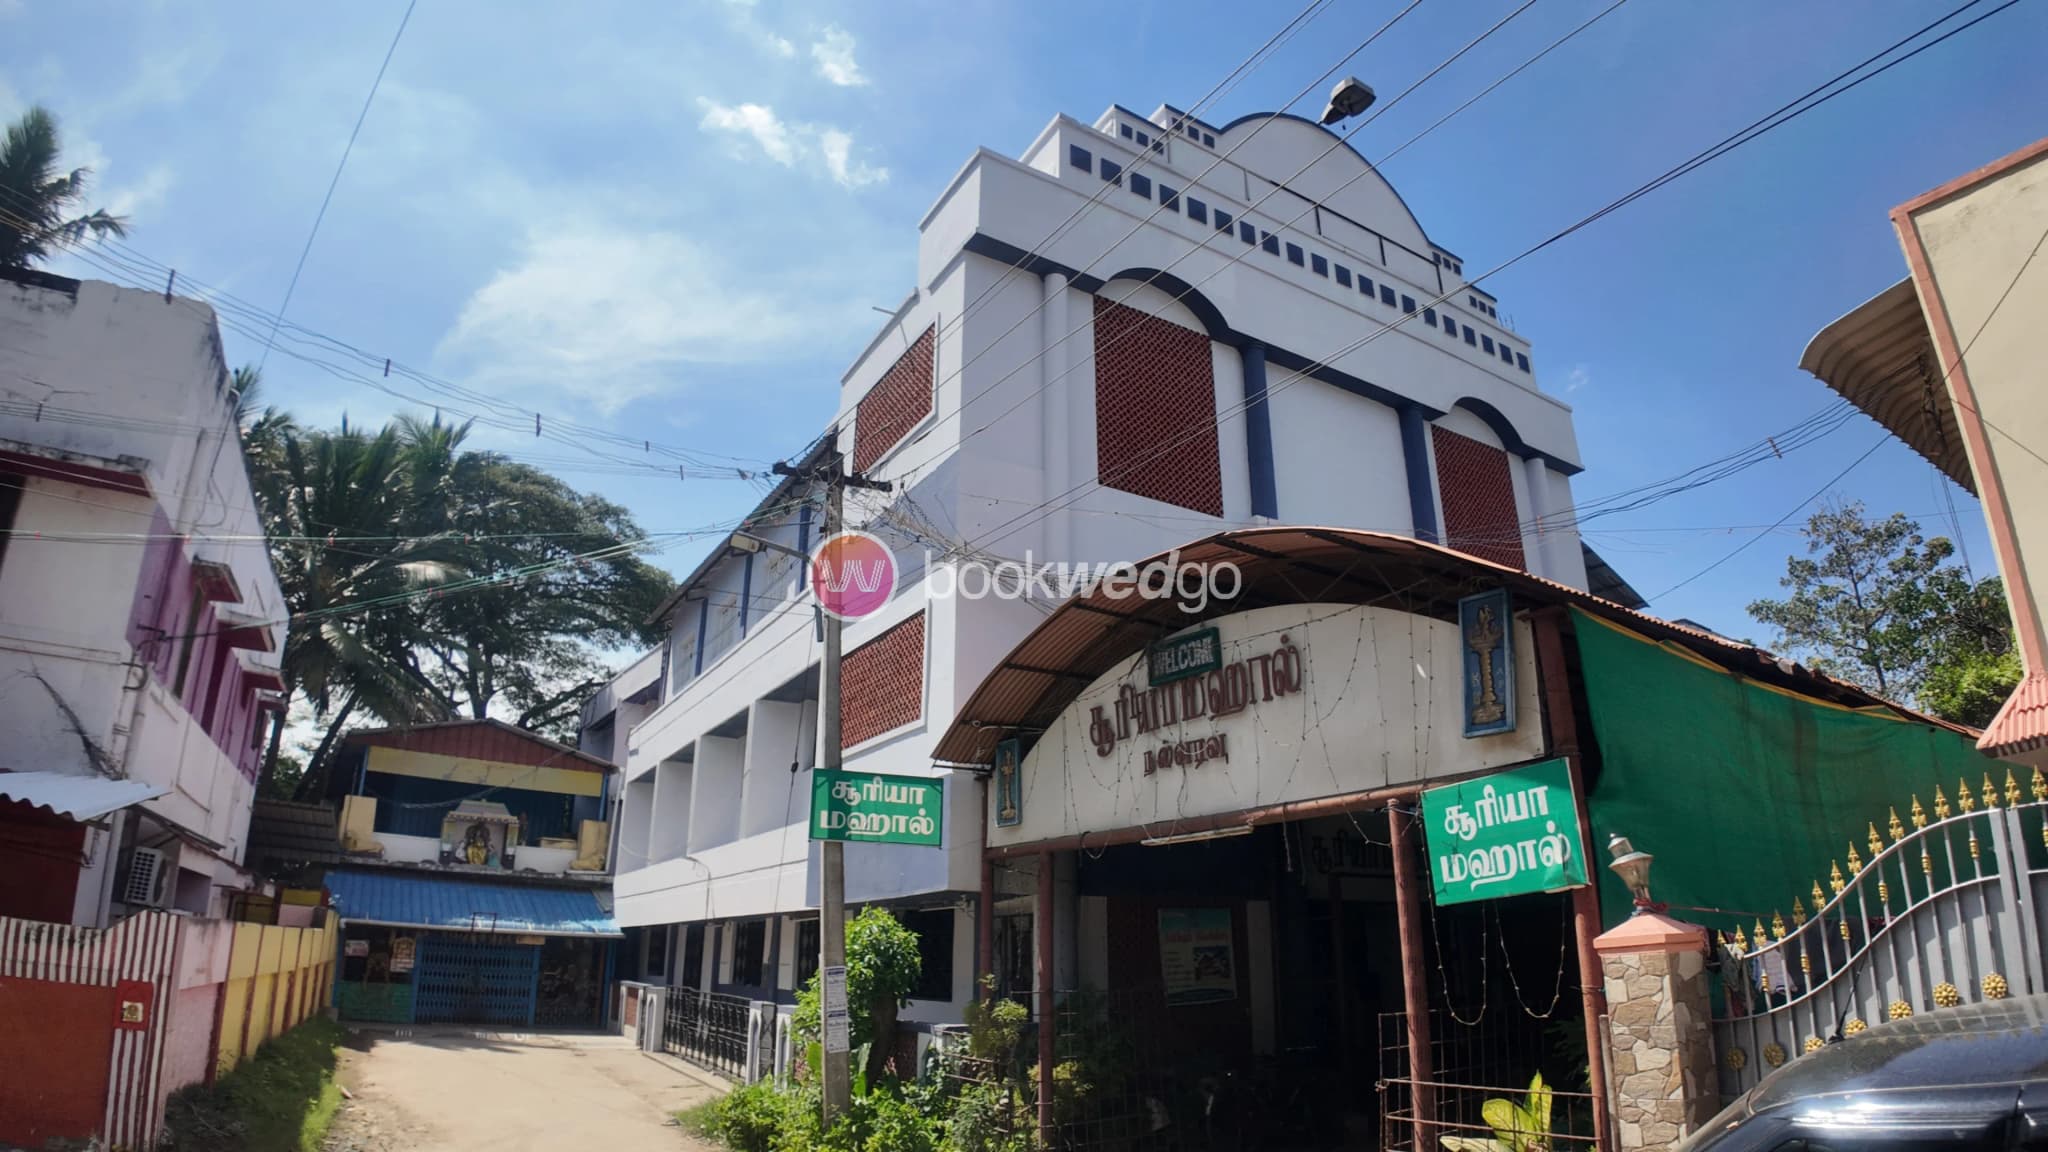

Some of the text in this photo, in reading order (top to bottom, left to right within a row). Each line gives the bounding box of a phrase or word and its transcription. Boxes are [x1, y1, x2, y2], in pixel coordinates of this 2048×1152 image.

[1152, 636, 1215, 677] WELCOME
[831, 776, 927, 806] சூரியா
[819, 807, 935, 837] மஹால்
[1444, 784, 1549, 841] சூரியா
[1440, 820, 1572, 892] மஹால்
